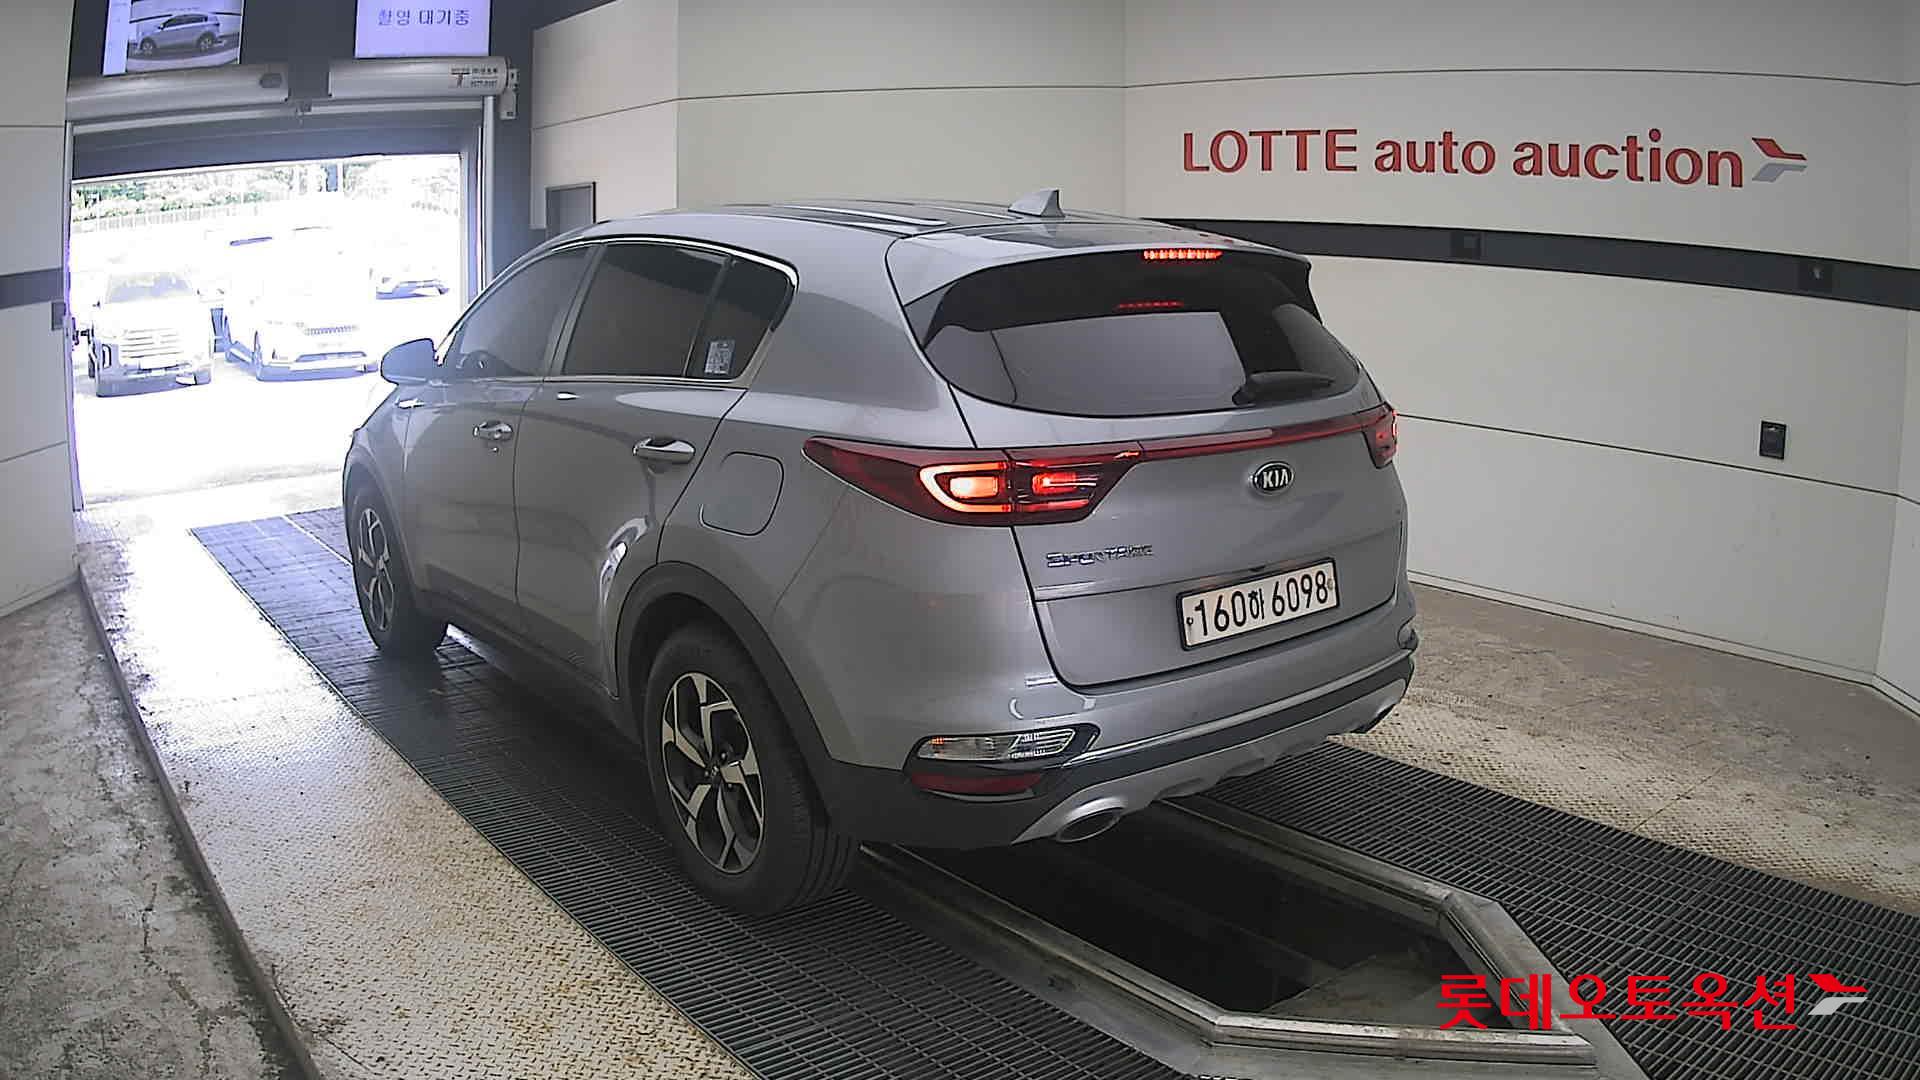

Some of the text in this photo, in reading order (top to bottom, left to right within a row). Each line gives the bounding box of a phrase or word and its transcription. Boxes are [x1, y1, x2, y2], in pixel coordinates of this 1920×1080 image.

[419, 9, 470, 26] 대기중
[1183, 128, 1743, 188] LOTTE auto auction
[1262, 468, 1289, 489] KIA
[1272, 570, 1328, 617] 6098
